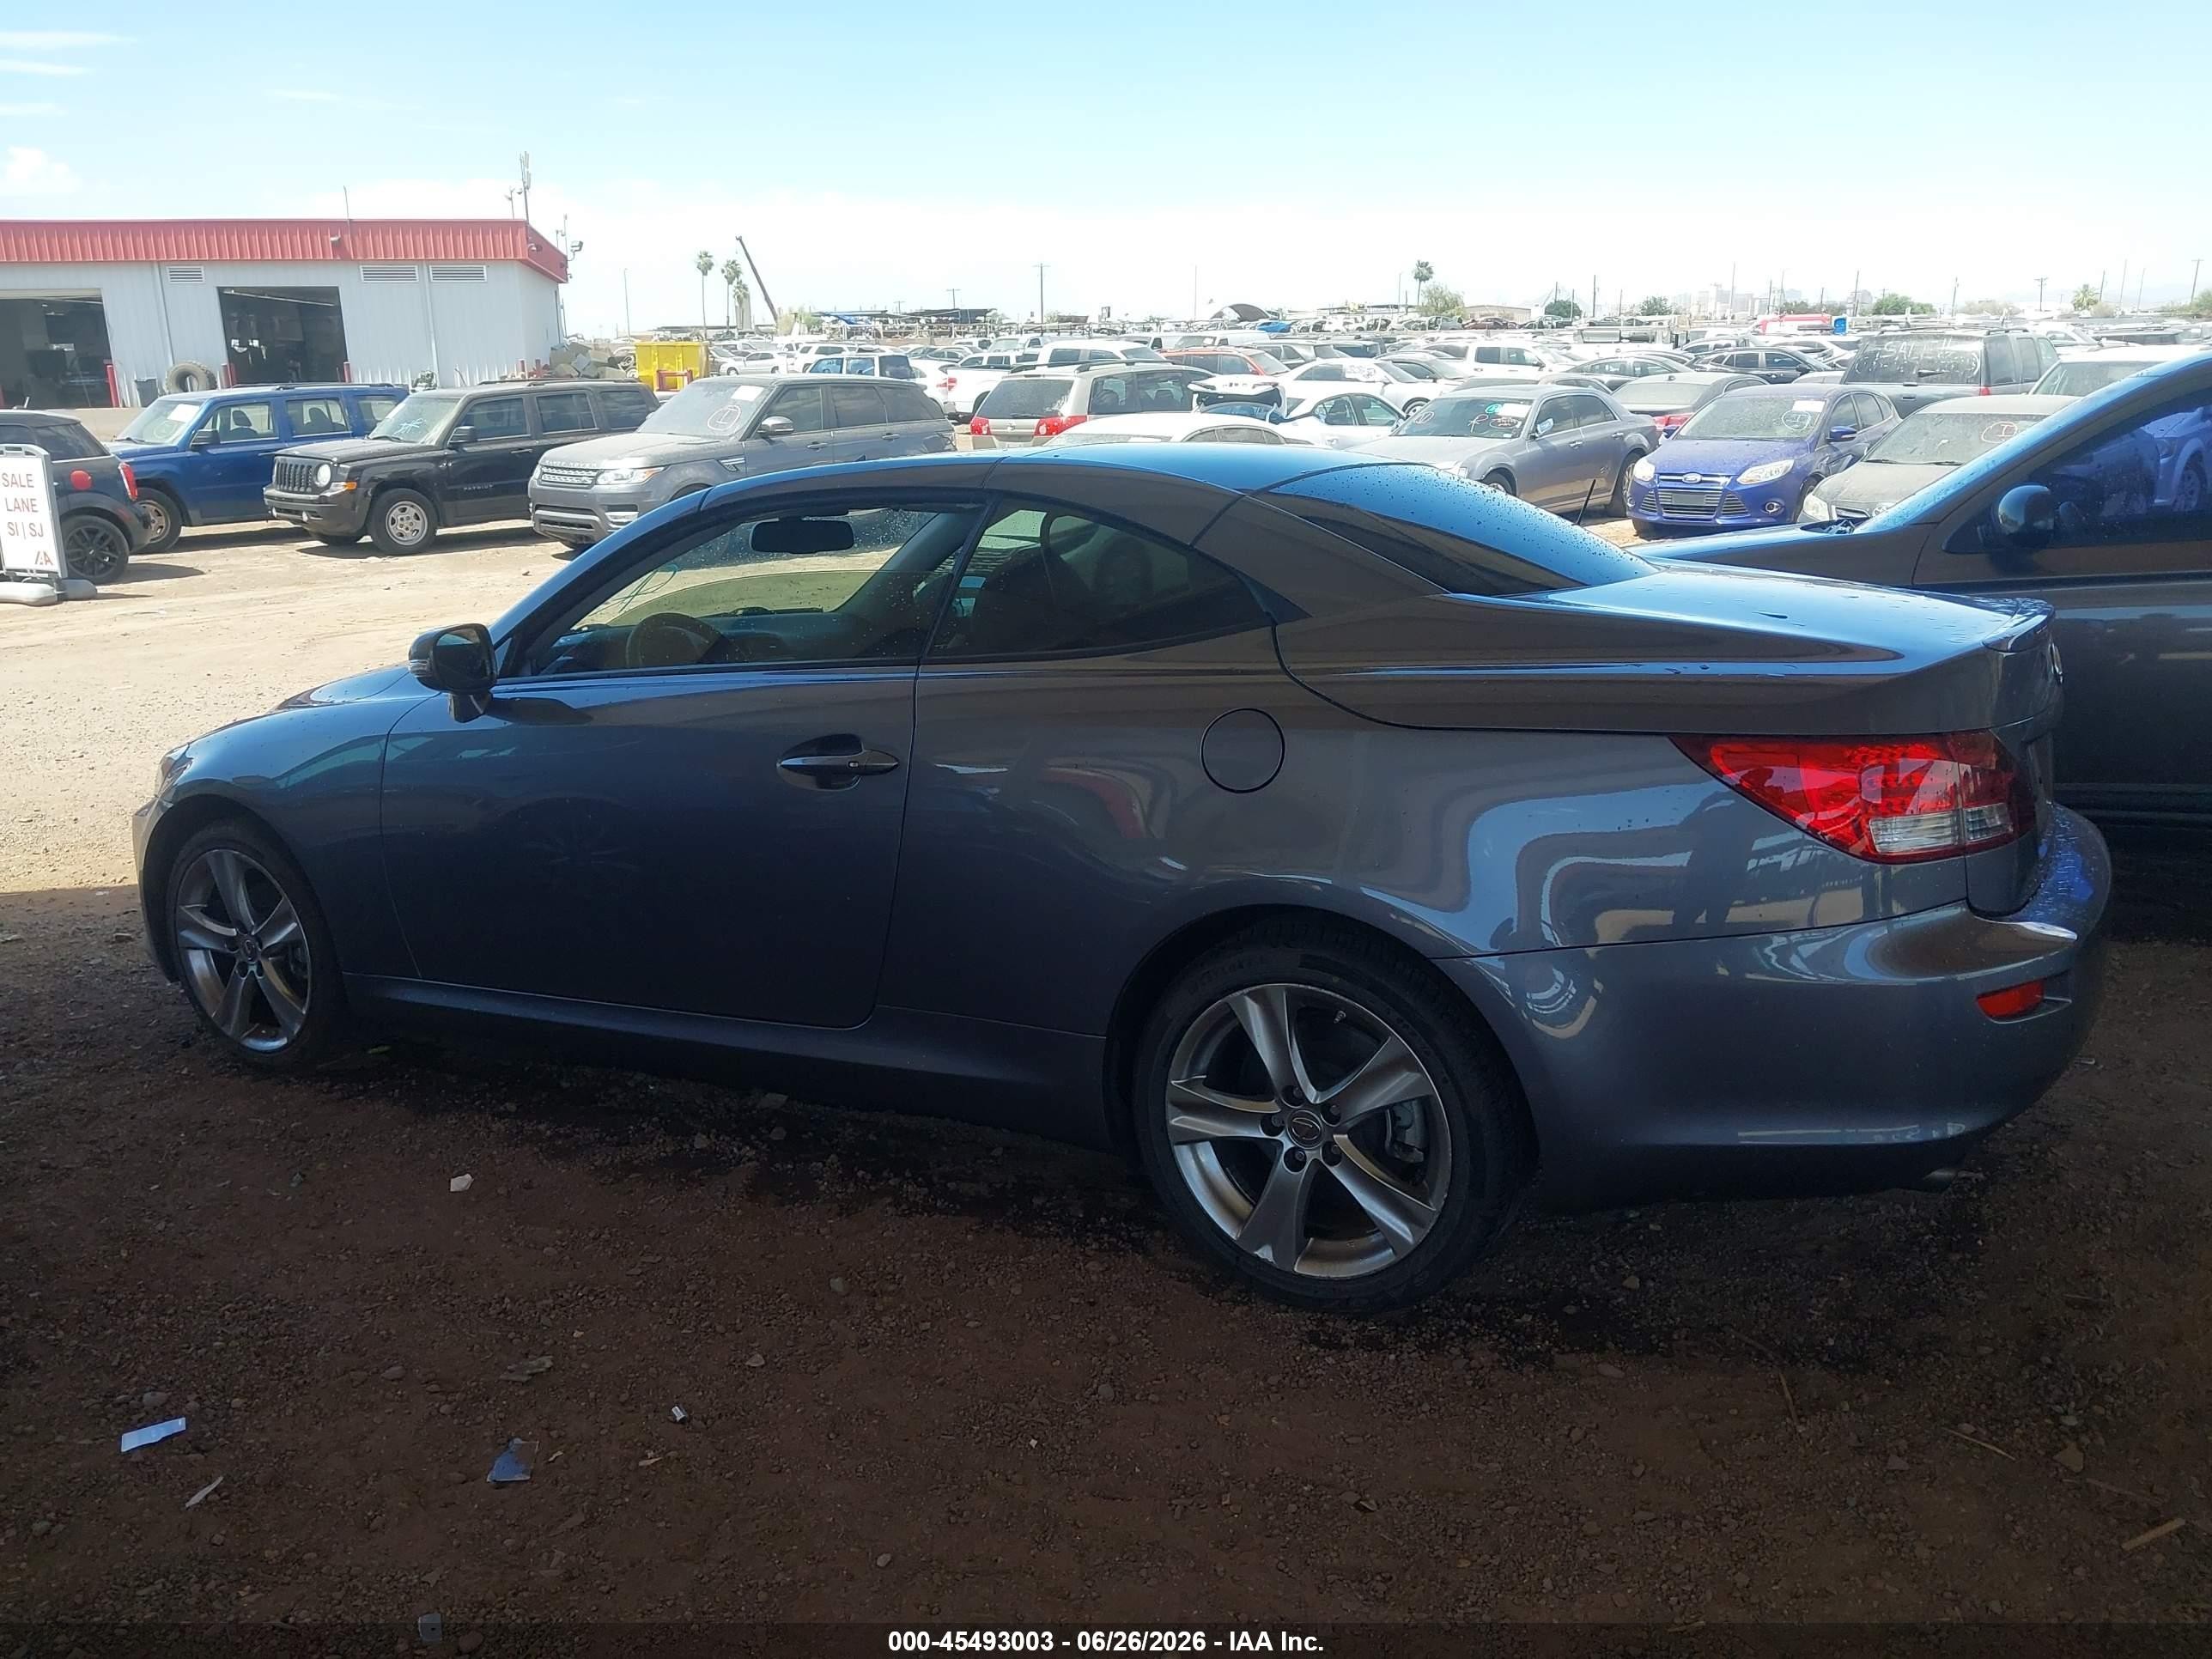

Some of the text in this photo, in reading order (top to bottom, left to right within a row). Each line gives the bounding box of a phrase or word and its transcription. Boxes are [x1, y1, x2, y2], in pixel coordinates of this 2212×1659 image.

[2, 472, 34, 488] SALE
[4, 497, 39, 513] LANE
[28, 522, 44, 538] SJ
